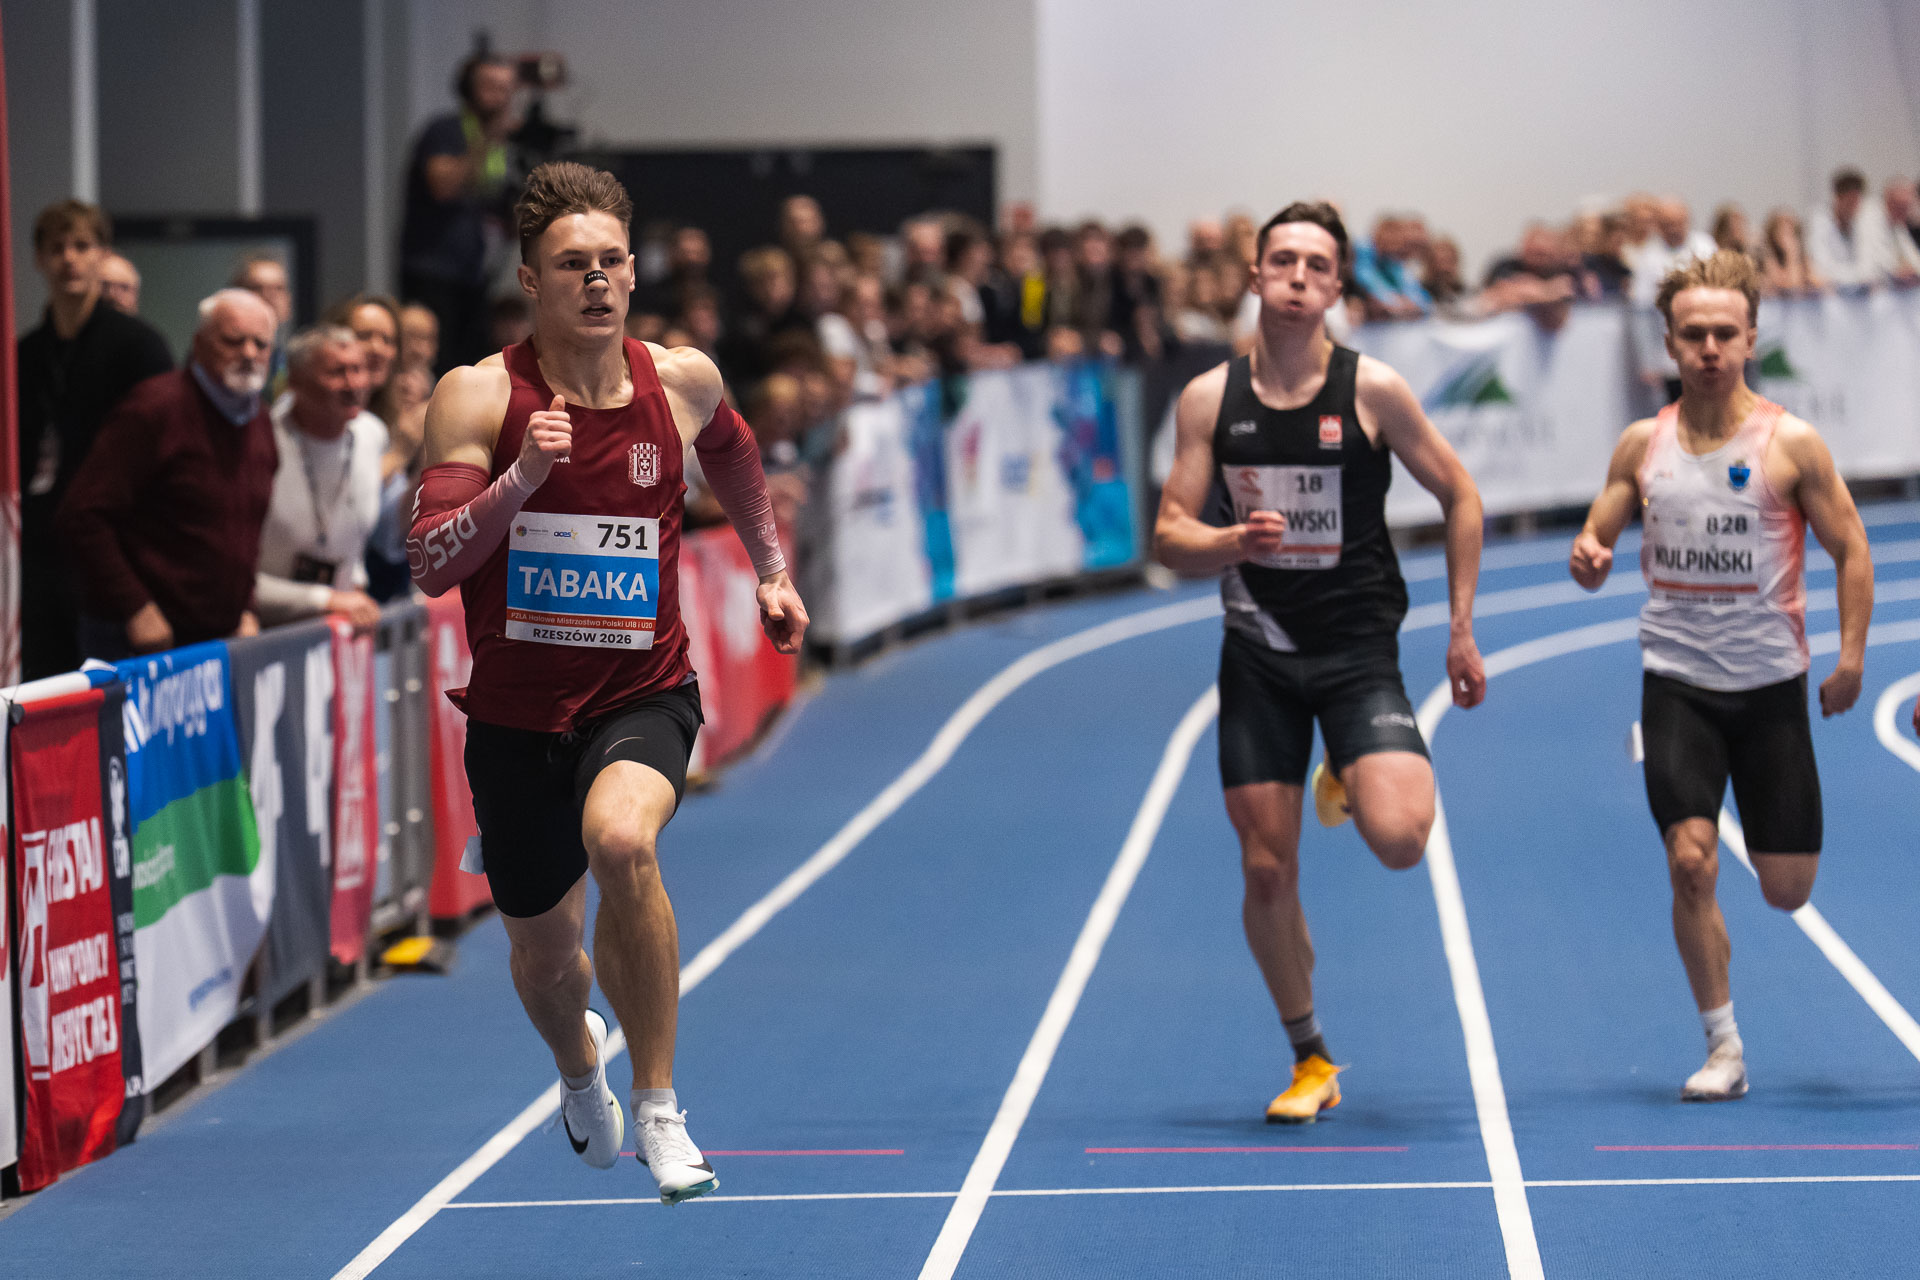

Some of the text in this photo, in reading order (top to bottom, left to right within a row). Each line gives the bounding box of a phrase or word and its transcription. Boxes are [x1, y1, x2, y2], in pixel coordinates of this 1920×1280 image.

[1296, 474, 1322, 494] 18
[1707, 514, 1747, 535] 828
[597, 523, 648, 550] 751
[1655, 545, 1753, 574] KULPIŃSKI
[518, 566, 648, 602] TABAKA
[529, 614, 556, 624] Halowe
[557, 616, 601, 626] Mistrzostwa
[602, 619, 624, 628] Polski
[625, 620, 637, 628] U18
[533, 628, 632, 644] RZESZÓW 2026
